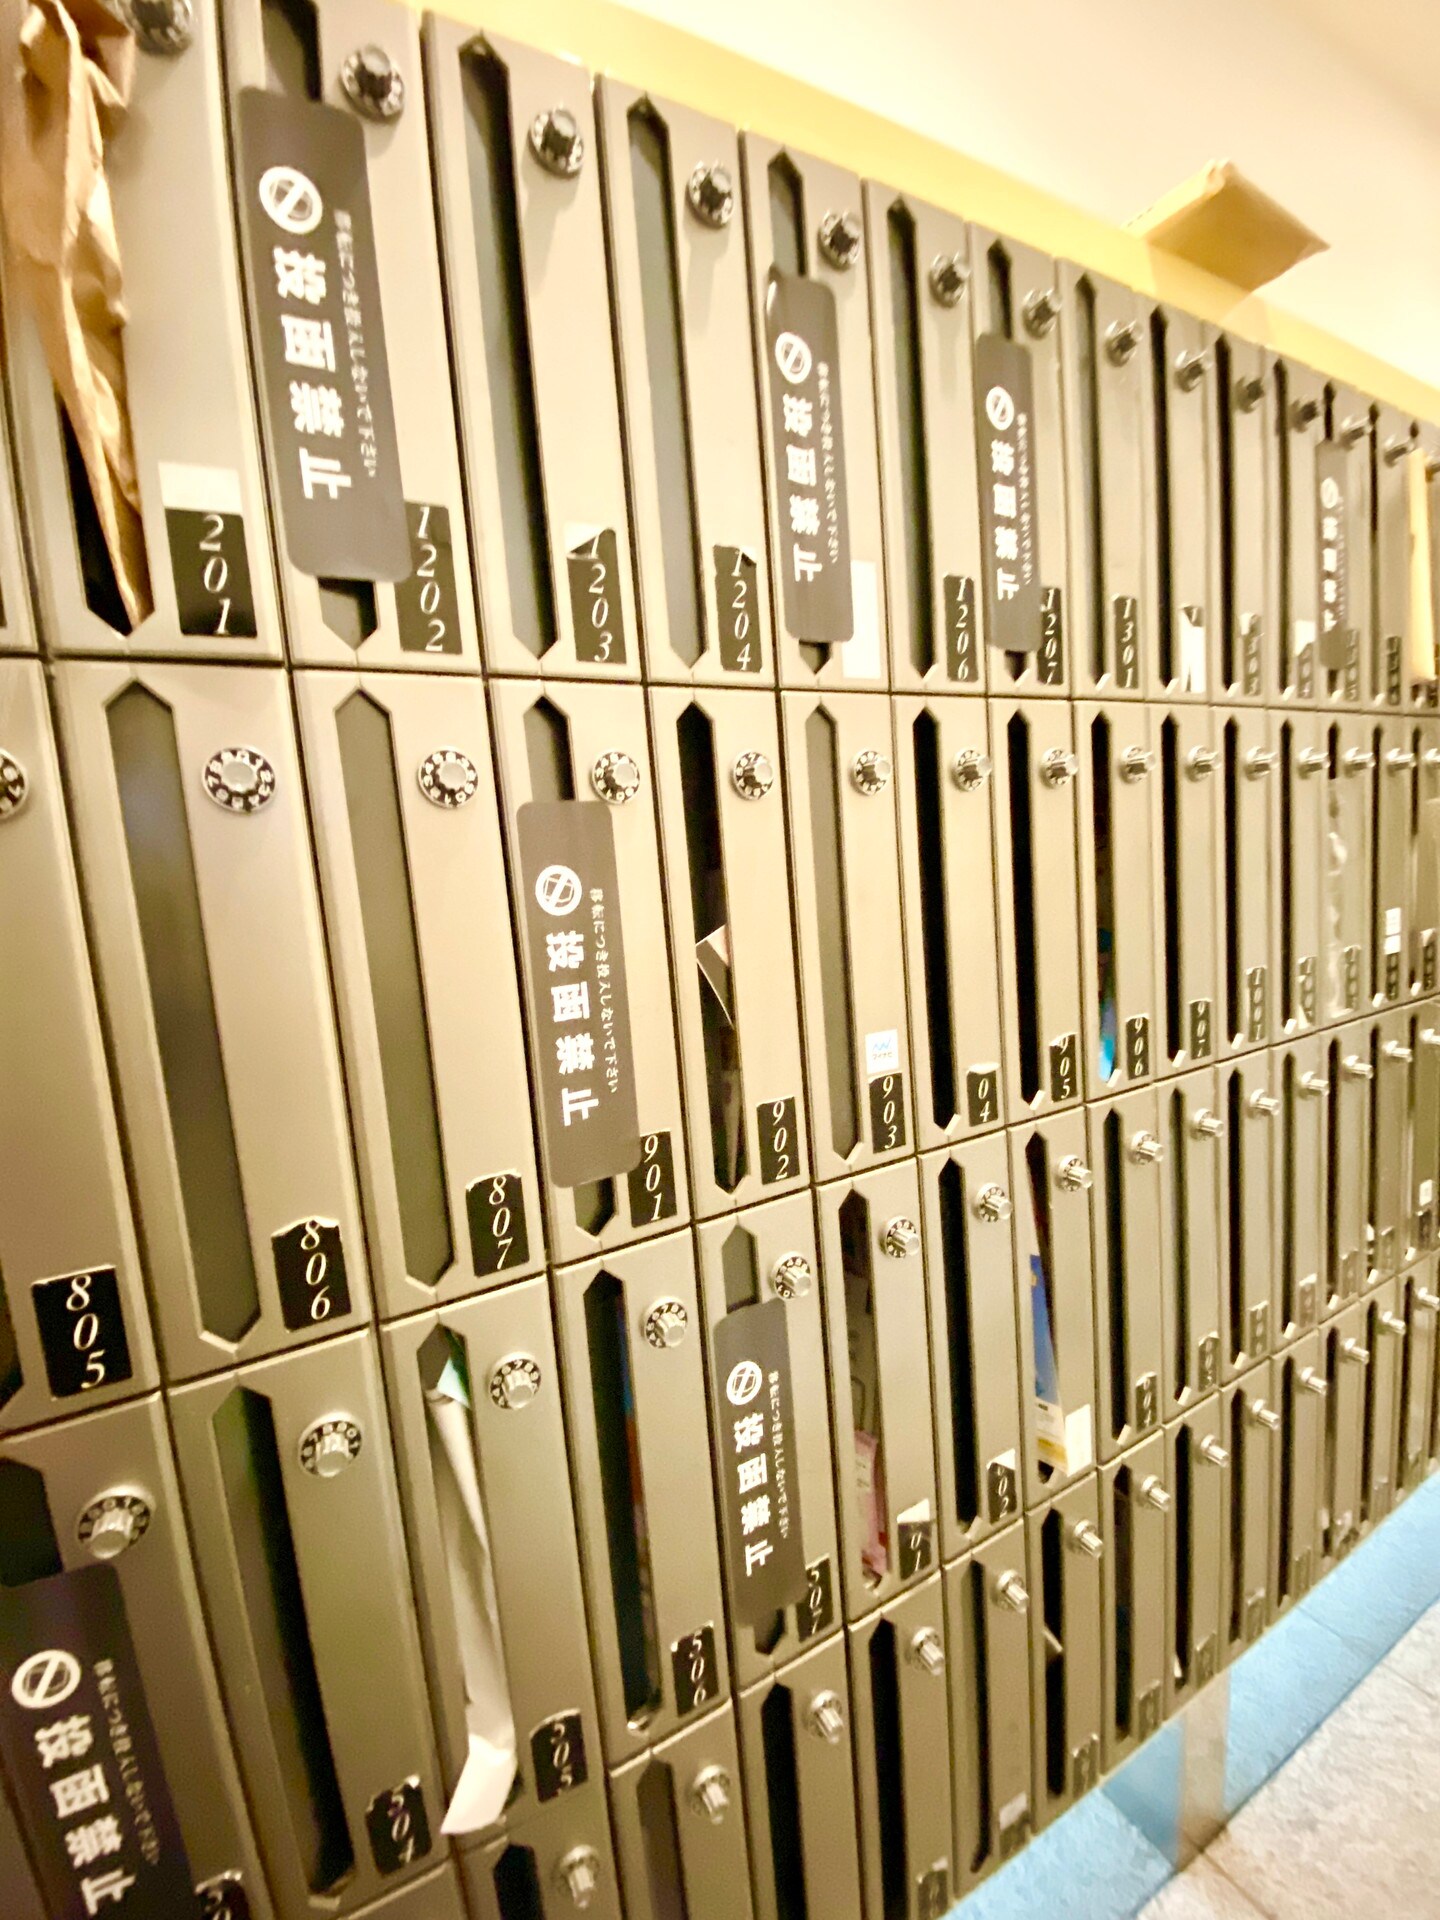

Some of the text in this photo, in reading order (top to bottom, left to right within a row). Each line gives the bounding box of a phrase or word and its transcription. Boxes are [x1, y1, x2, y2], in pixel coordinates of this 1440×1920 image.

[416, 506, 446, 652] 1202
[588, 534, 613, 662] 1203
[731, 549, 752, 671] 1204
[955, 577, 970, 681] 1206
[1044, 588, 1057, 684] 1207
[1122, 599, 1134, 687] 1301
[1134, 1017, 1144, 1076] 906
[1196, 1001, 1206, 1057] 907
[1253, 968, 1262, 1041] 1001
[978, 1078, 991, 1123] 04
[1059, 1035, 1071, 1100] 905
[772, 1100, 789, 1180] 902
[882, 1075, 898, 1149] 903
[643, 1134, 662, 1221] 901
[488, 1175, 514, 1271] 807
[300, 1220, 331, 1321] 806
[66, 1274, 105, 1389] 805
[808, 1569, 823, 1635] 507
